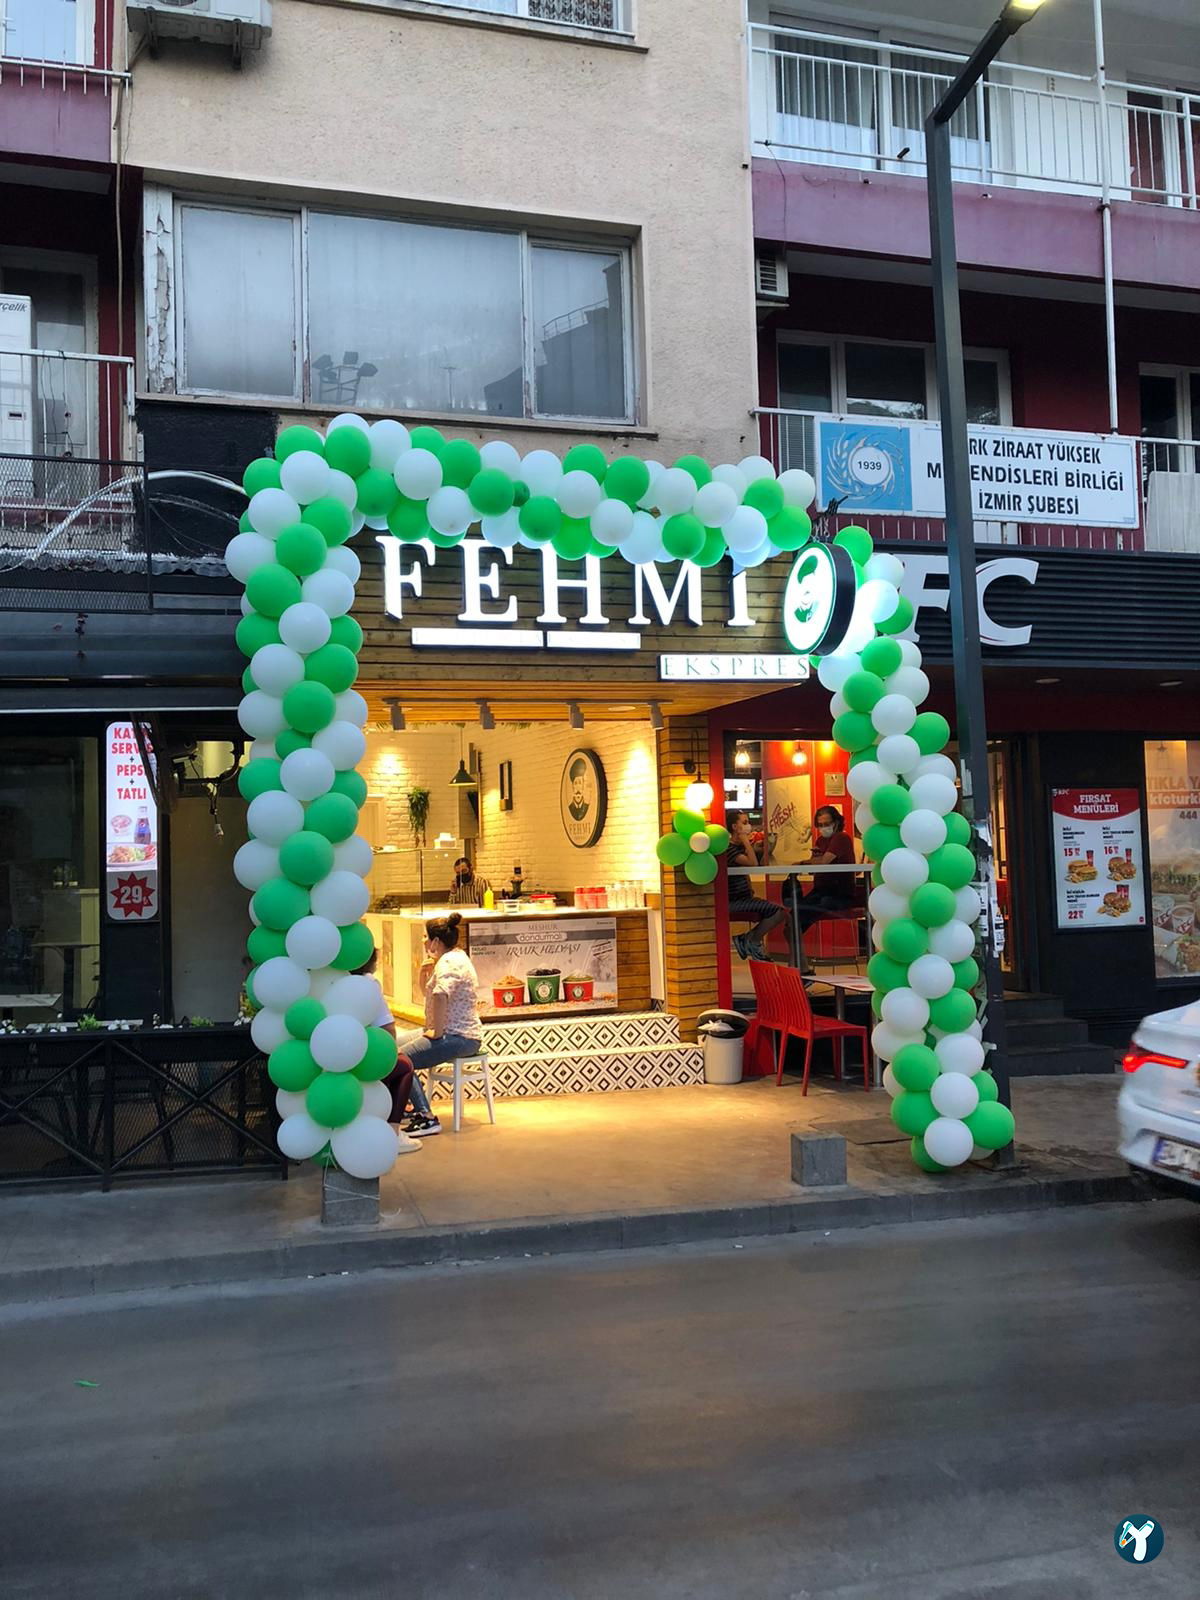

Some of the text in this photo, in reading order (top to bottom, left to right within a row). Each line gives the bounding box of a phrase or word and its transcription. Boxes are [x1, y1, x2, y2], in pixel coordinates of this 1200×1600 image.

[969, 436, 1102, 464] RK ZİRAAT YÜKSEK
[857, 460, 883, 471] 1939
[927, 462, 1124, 491] MENDİSLERİ BİRLİĞİ
[978, 489, 1079, 515] İZMİR ŞUBESİ
[884, 553, 1039, 646] FC
[664, 656, 808, 676] EKSPRES
[116, 764, 145, 776] PEPS
[116, 788, 147, 799] TATLI
[769, 802, 795, 832] FRESH
